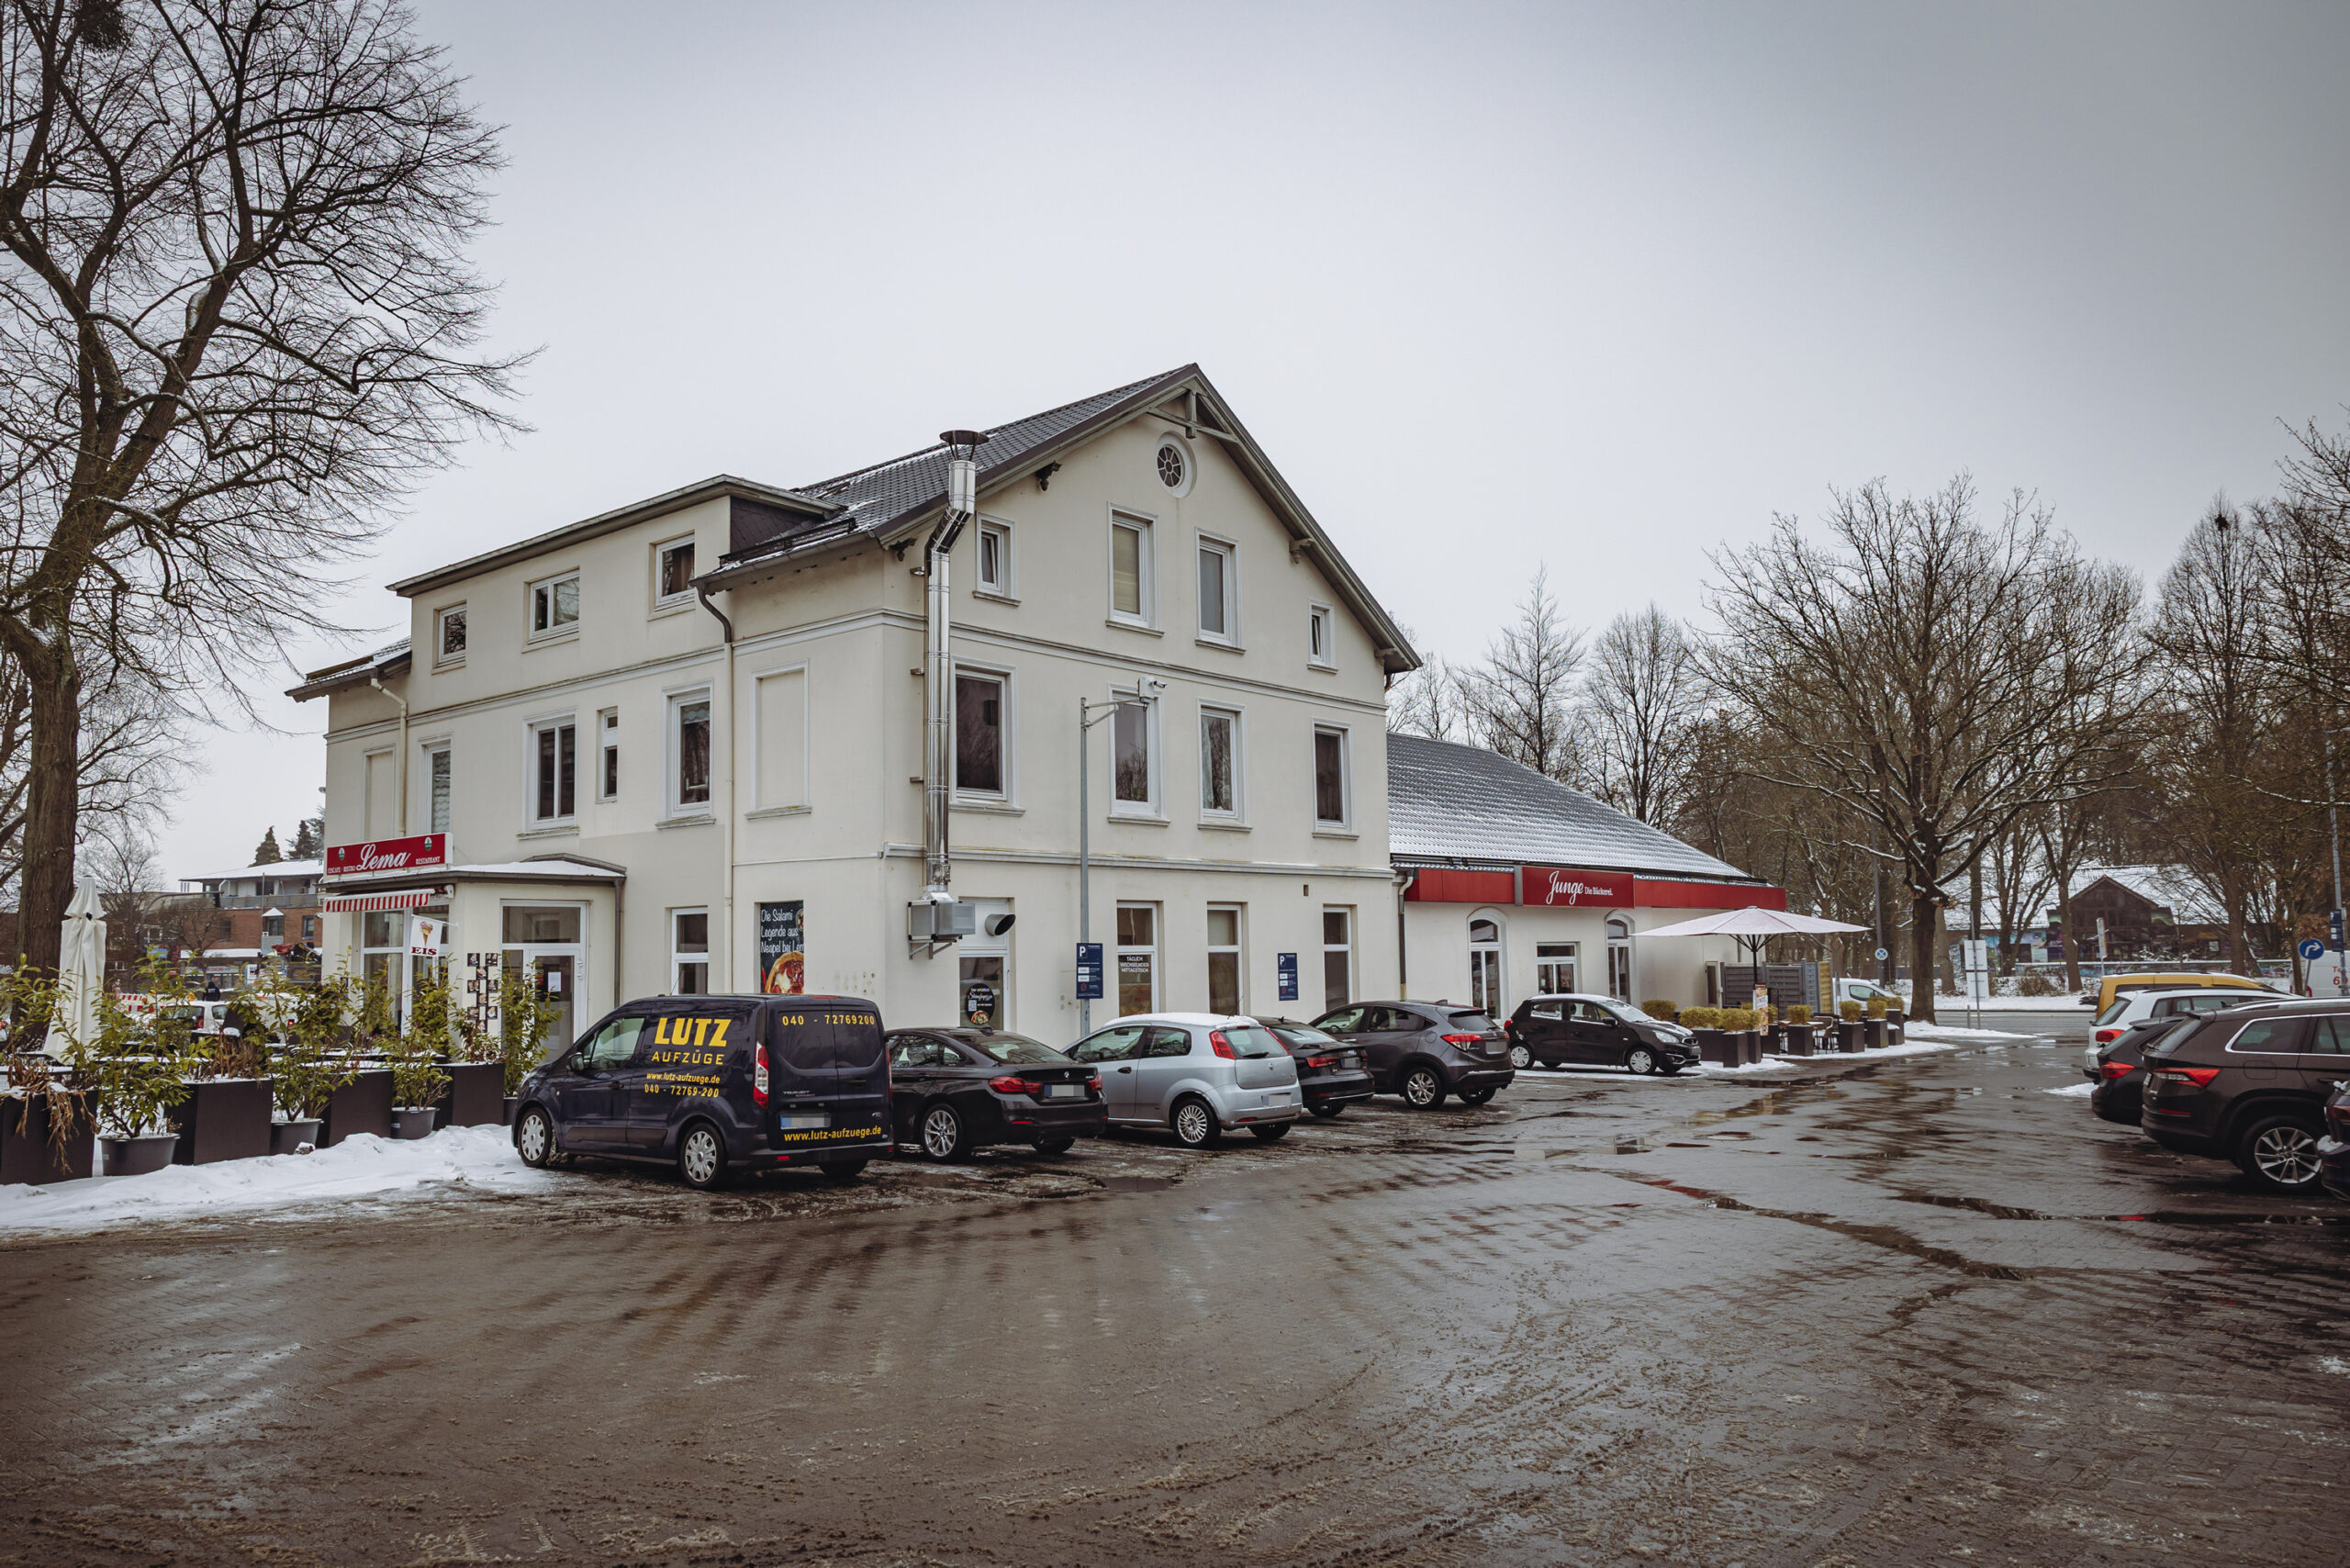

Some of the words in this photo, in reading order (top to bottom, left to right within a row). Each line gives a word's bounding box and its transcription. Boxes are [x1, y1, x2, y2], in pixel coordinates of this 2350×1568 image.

[356, 844, 410, 870] Lema
[1546, 870, 1583, 905] Junge
[761, 909, 771, 922] Die
[772, 908, 793, 922] Salami
[761, 924, 786, 941] Legende
[788, 927, 799, 936] aus
[411, 946, 437, 956] EIS
[761, 940, 780, 957] Neapel
[782, 940, 791, 953] bei
[1079, 946, 1086, 957] P
[1280, 956, 1284, 965] P
[782, 1015, 804, 1025] 040
[825, 1014, 875, 1025] 72769200
[655, 1017, 732, 1047] LUTZ
[651, 1049, 724, 1065] AUFZÜGE
[646, 1072, 720, 1084] www.lutz-aufzuege.de
[644, 1084, 659, 1093] 040
[671, 1085, 719, 1098] 72769-200
[784, 1126, 881, 1141] www.lutz-aufzuege.de
